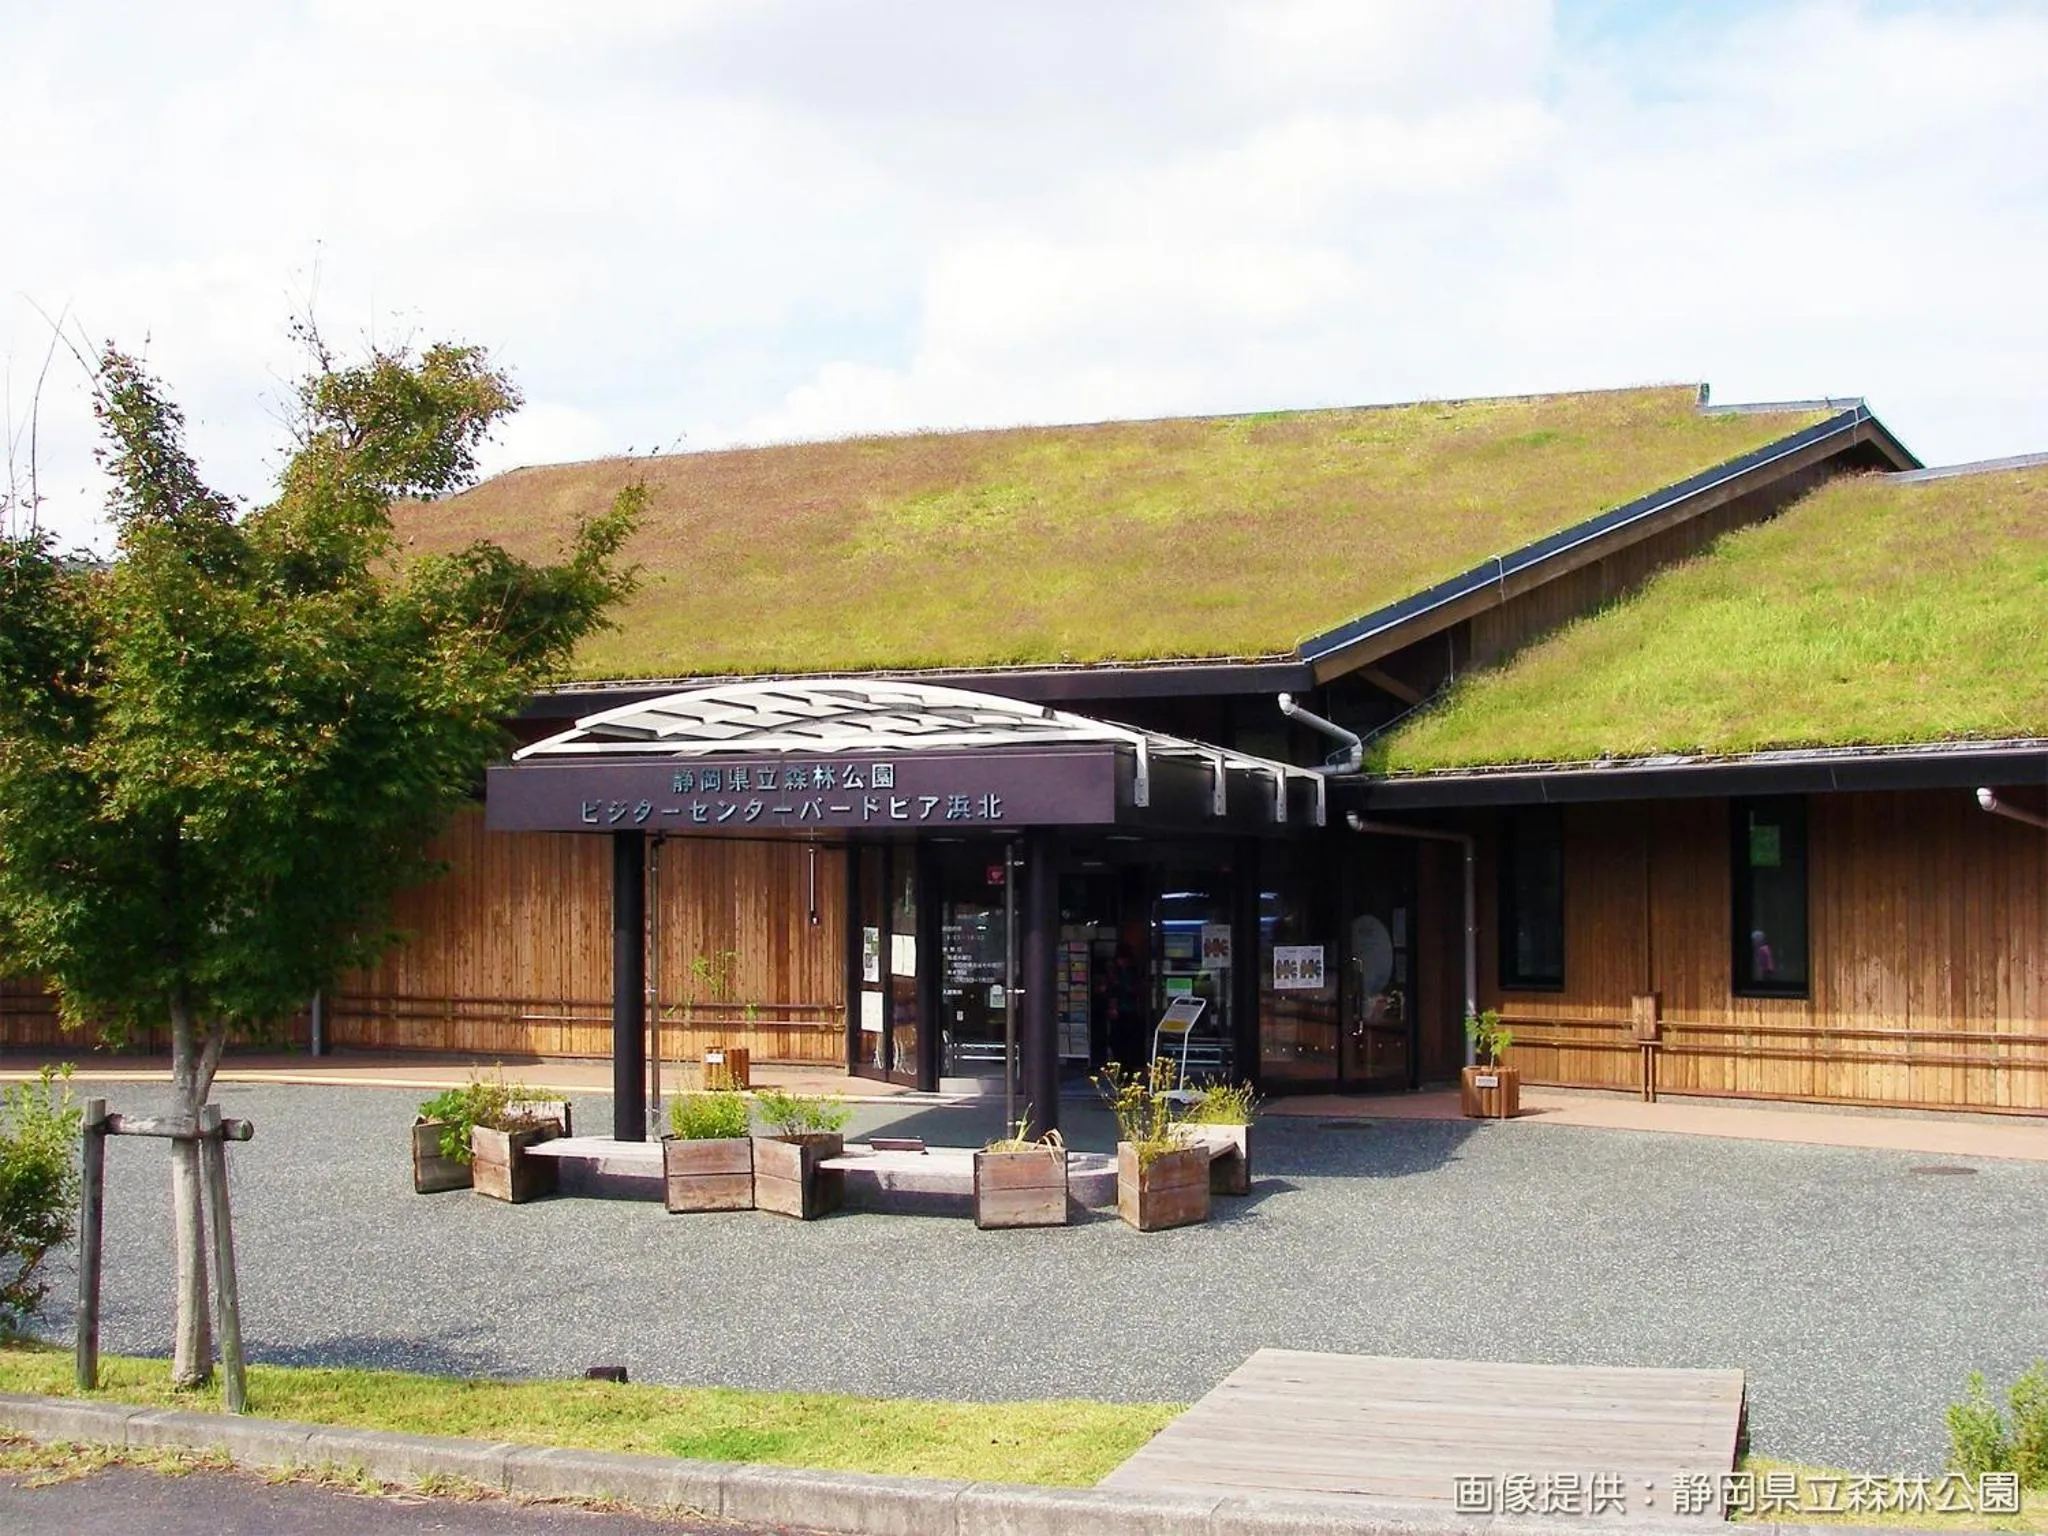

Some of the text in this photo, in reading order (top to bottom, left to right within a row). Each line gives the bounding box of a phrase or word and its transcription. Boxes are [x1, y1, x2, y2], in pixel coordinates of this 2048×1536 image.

[671, 763, 895, 792] 静岡県立森林公園
